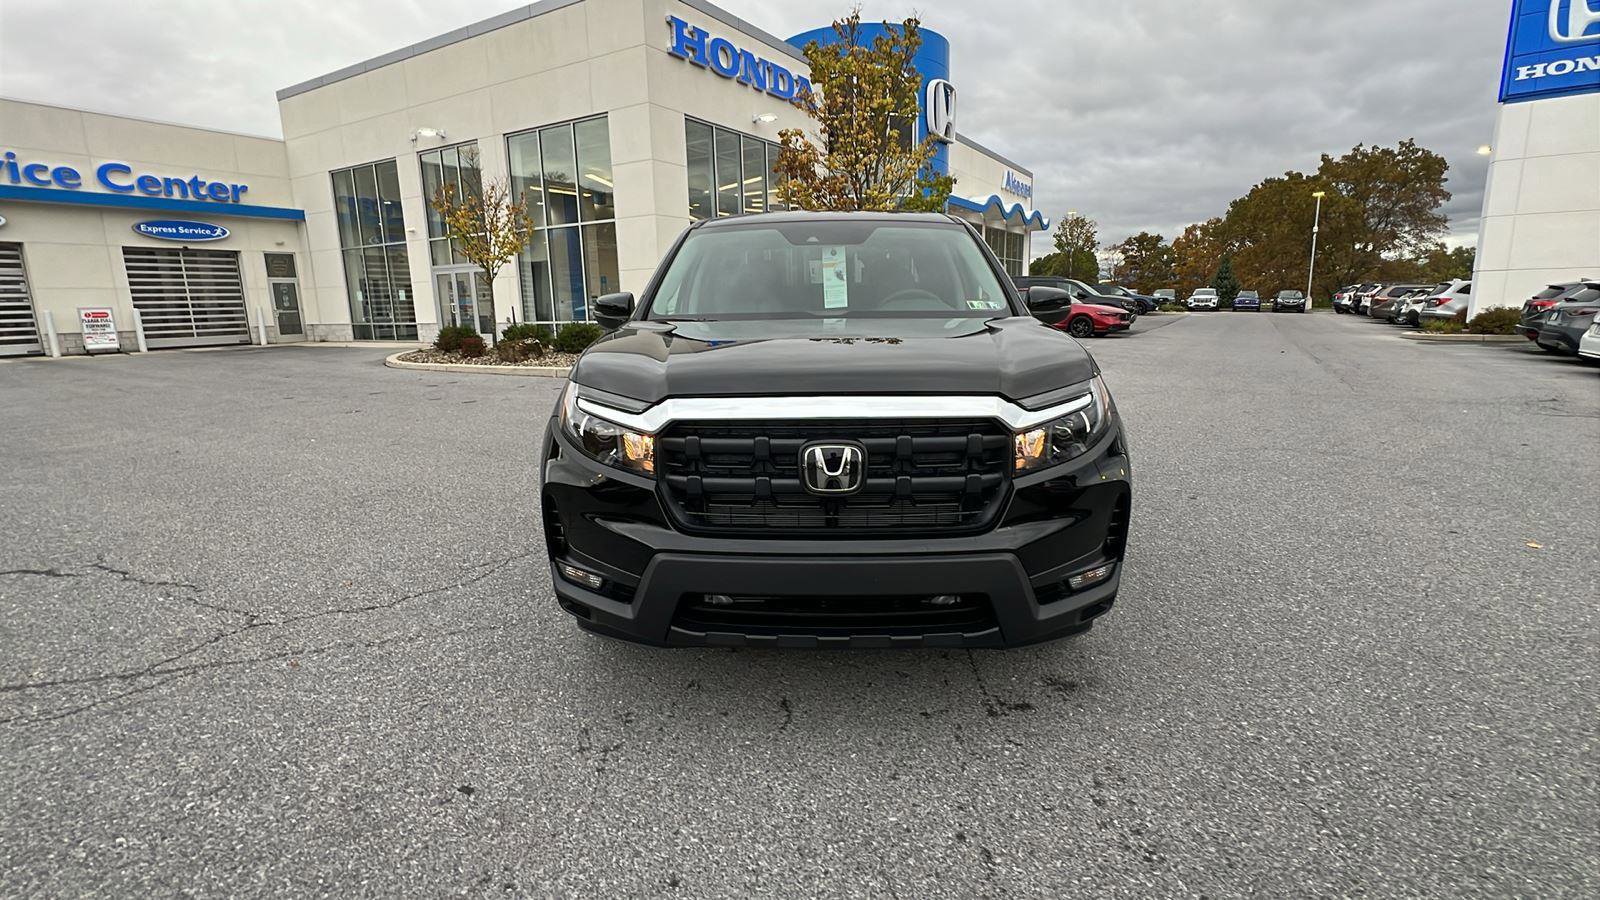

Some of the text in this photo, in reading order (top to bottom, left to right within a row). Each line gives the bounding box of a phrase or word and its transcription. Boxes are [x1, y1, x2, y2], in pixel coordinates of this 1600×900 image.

[665, 15, 819, 110] HONDA
[0, 151, 248, 203] ice Center
[140, 224, 212, 235] Express Service
